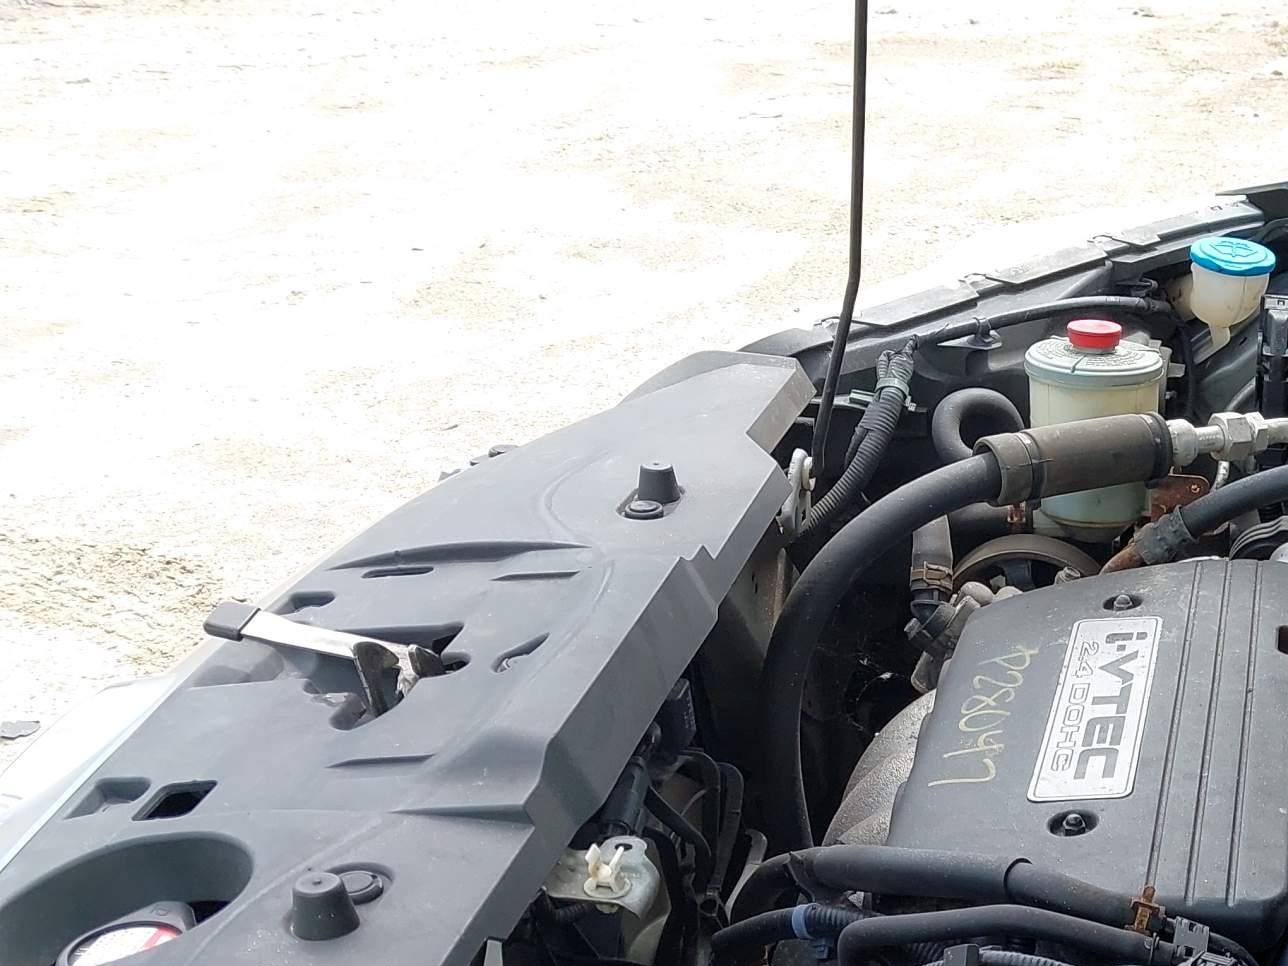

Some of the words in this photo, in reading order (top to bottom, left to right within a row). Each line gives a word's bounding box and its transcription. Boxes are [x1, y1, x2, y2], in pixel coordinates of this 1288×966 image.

[1075, 641, 1099, 678] 2.4
[1051, 683, 1090, 771] DOHC
[1074, 632, 1147, 780] i-VTEC
